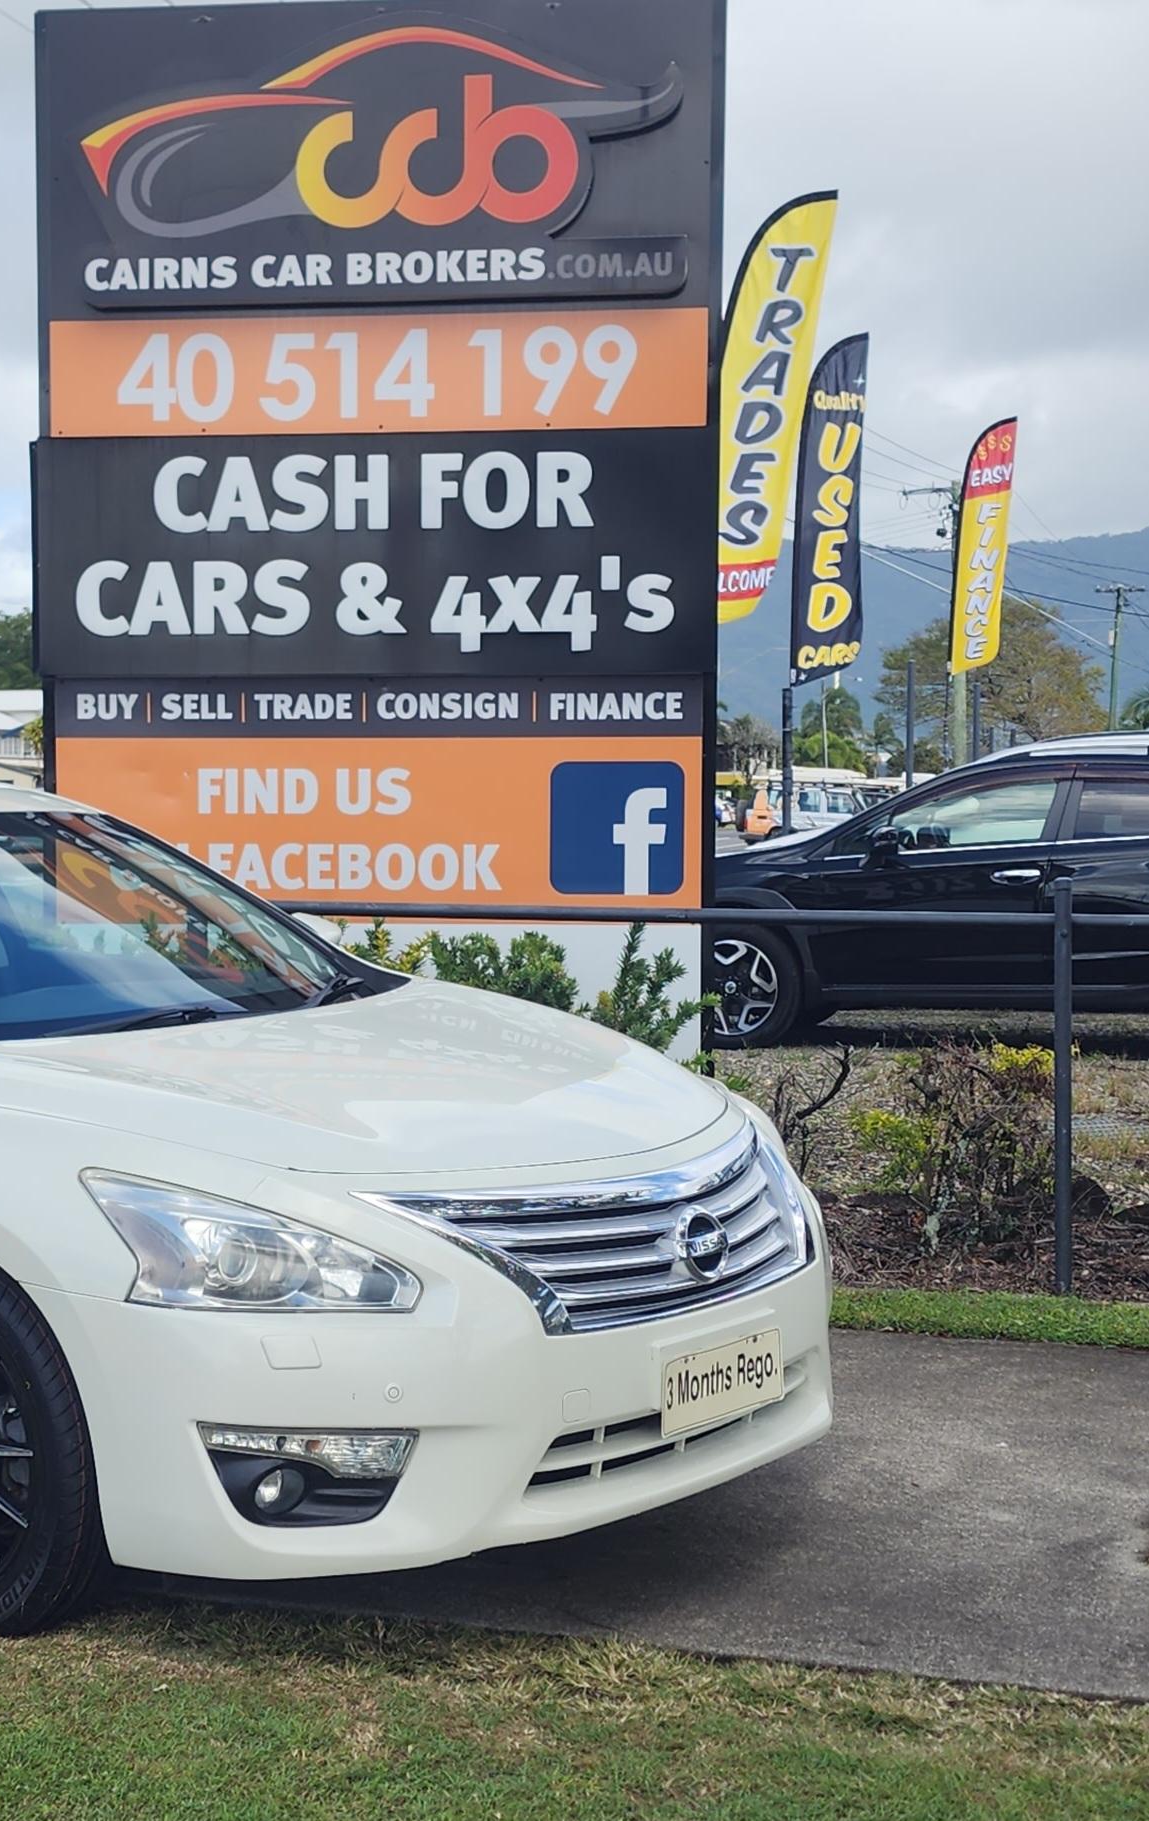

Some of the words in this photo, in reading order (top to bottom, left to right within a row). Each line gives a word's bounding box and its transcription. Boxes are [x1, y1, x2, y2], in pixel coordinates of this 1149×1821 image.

[84, 256, 238, 291] CAIRNS
[251, 254, 333, 288] CAR
[117, 332, 235, 423] 40
[259, 328, 435, 422] 514
[467, 324, 638, 417] 199
[718, 247, 815, 547] TRADES
[153, 453, 389, 533] CASH
[420, 450, 595, 530] FOR
[971, 462, 1013, 487] EASY
[806, 421, 862, 633] USED
[75, 558, 312, 638] CARS
[335, 561, 408, 637] &
[718, 566, 776, 593] LCOME
[965, 503, 1002, 660] FINANCE
[797, 641, 861, 669] CARS
[77, 693, 139, 720] BUY
[161, 693, 234, 720] SELL
[254, 693, 353, 720] TRADE
[377, 692, 519, 720] CONSIGN
[550, 691, 684, 720] FINANCE
[197, 768, 319, 816] FIND
[335, 767, 413, 816] US
[208, 842, 502, 891] FACEBOOK
[666, 1376, 674, 1410] 3
[677, 1362, 733, 1404] Months
[737, 1352, 778, 1389] Rego.
